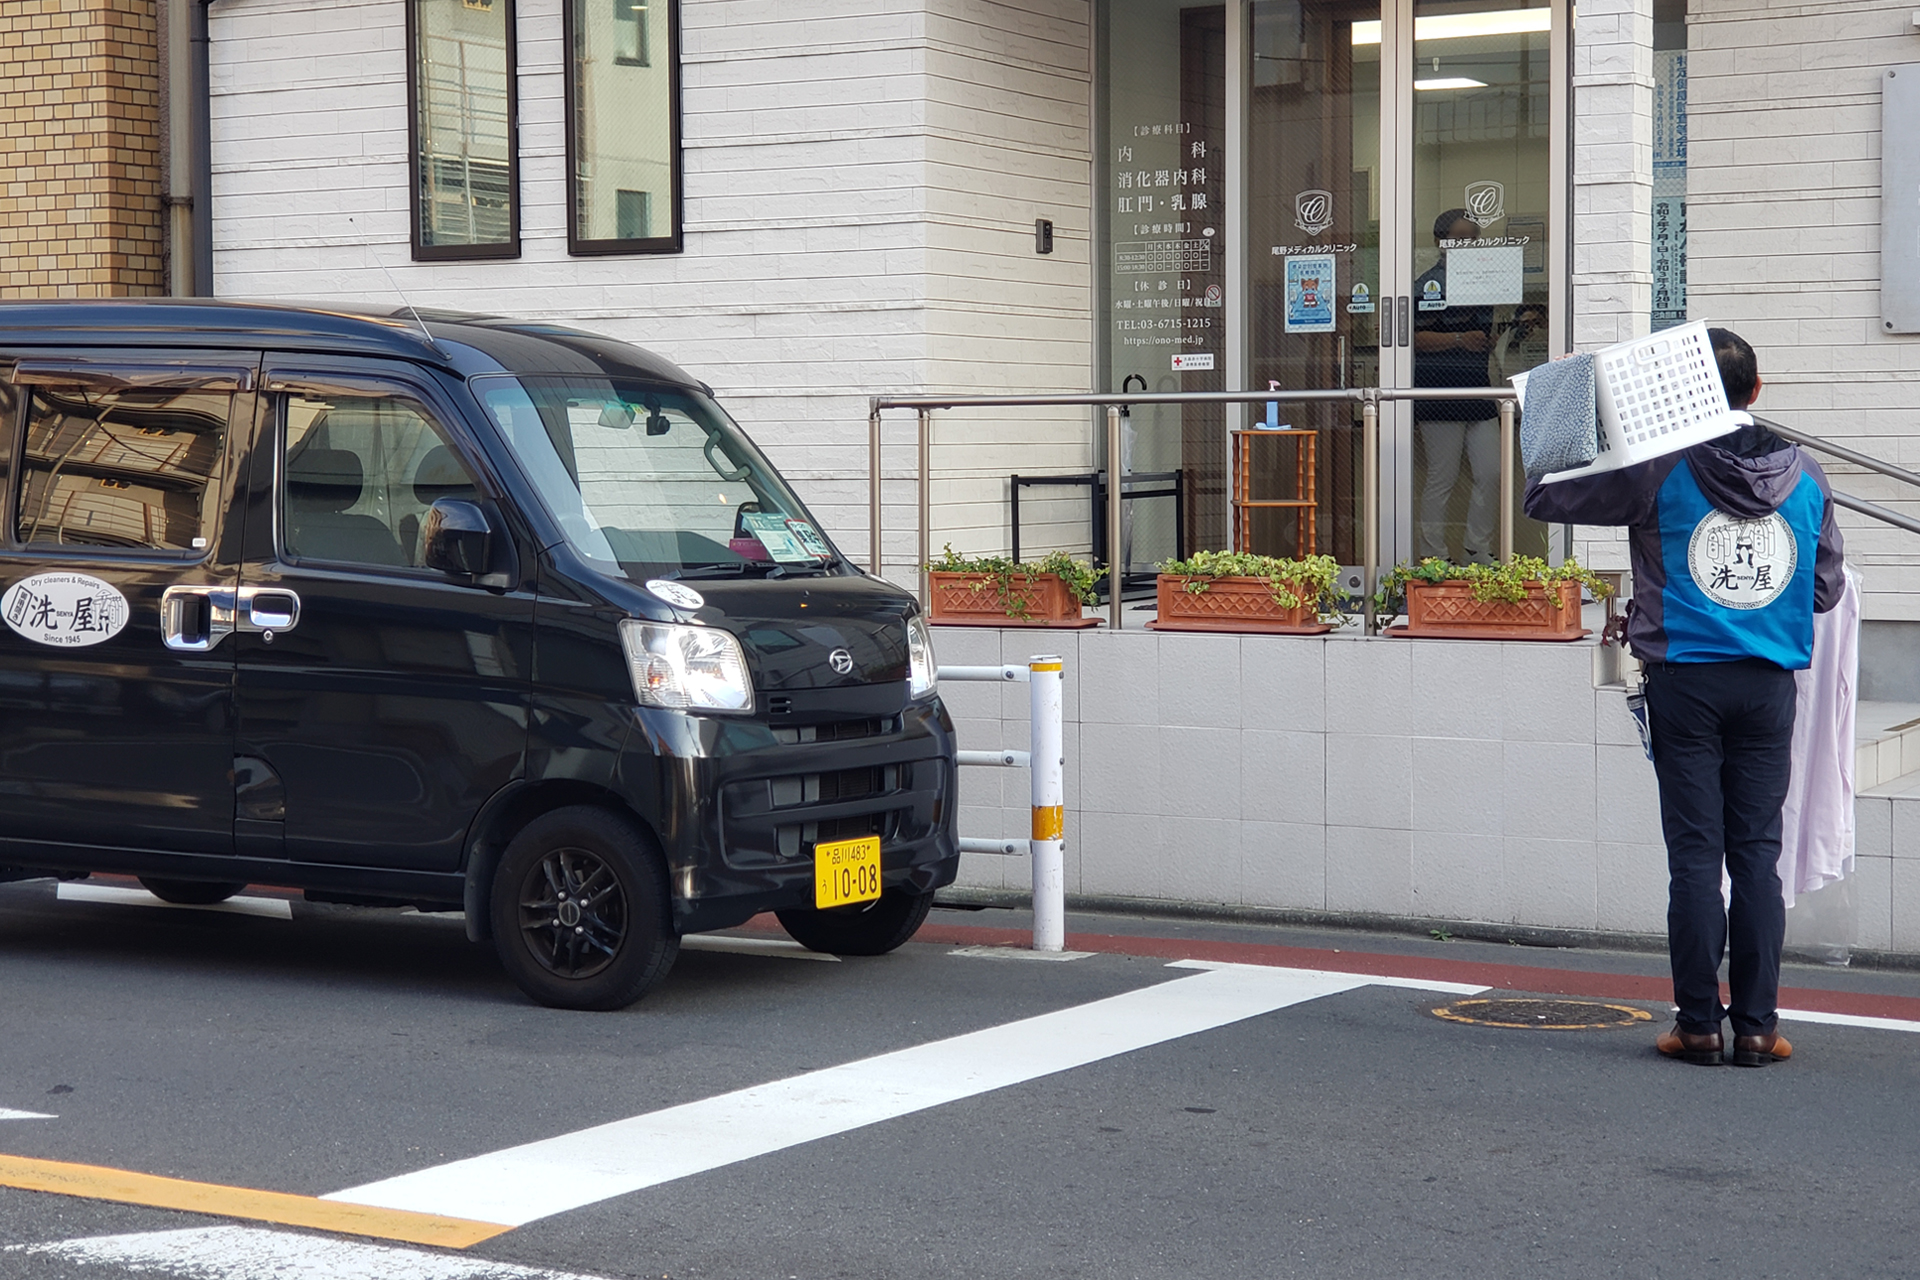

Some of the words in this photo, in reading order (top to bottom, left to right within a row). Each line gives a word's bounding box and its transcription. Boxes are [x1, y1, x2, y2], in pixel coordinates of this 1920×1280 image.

[1118, 168, 1207, 188] 消化器内科
[1117, 193, 1207, 213] 肛門・乳腺
[1439, 236, 1530, 248] 尾野メディカルクリニック
[1271, 243, 1357, 255] 尾野メディカルクリニック
[1116, 318, 1211, 330] TEL:03-6715-1215
[1124, 335, 1204, 346] https://ono-med.jp
[31, 579, 42, 587] Dry
[44, 576, 70, 584] cleaners
[77, 577, 100, 589] Repairs
[1710, 565, 1739, 590] 洗
[1750, 564, 1774, 591] 屋
[30, 594, 58, 630] 洗
[69, 597, 97, 632] 屋
[44, 633, 63, 643] Since
[65, 635, 81, 643] 1945
[834, 863, 877, 900] 10-08
